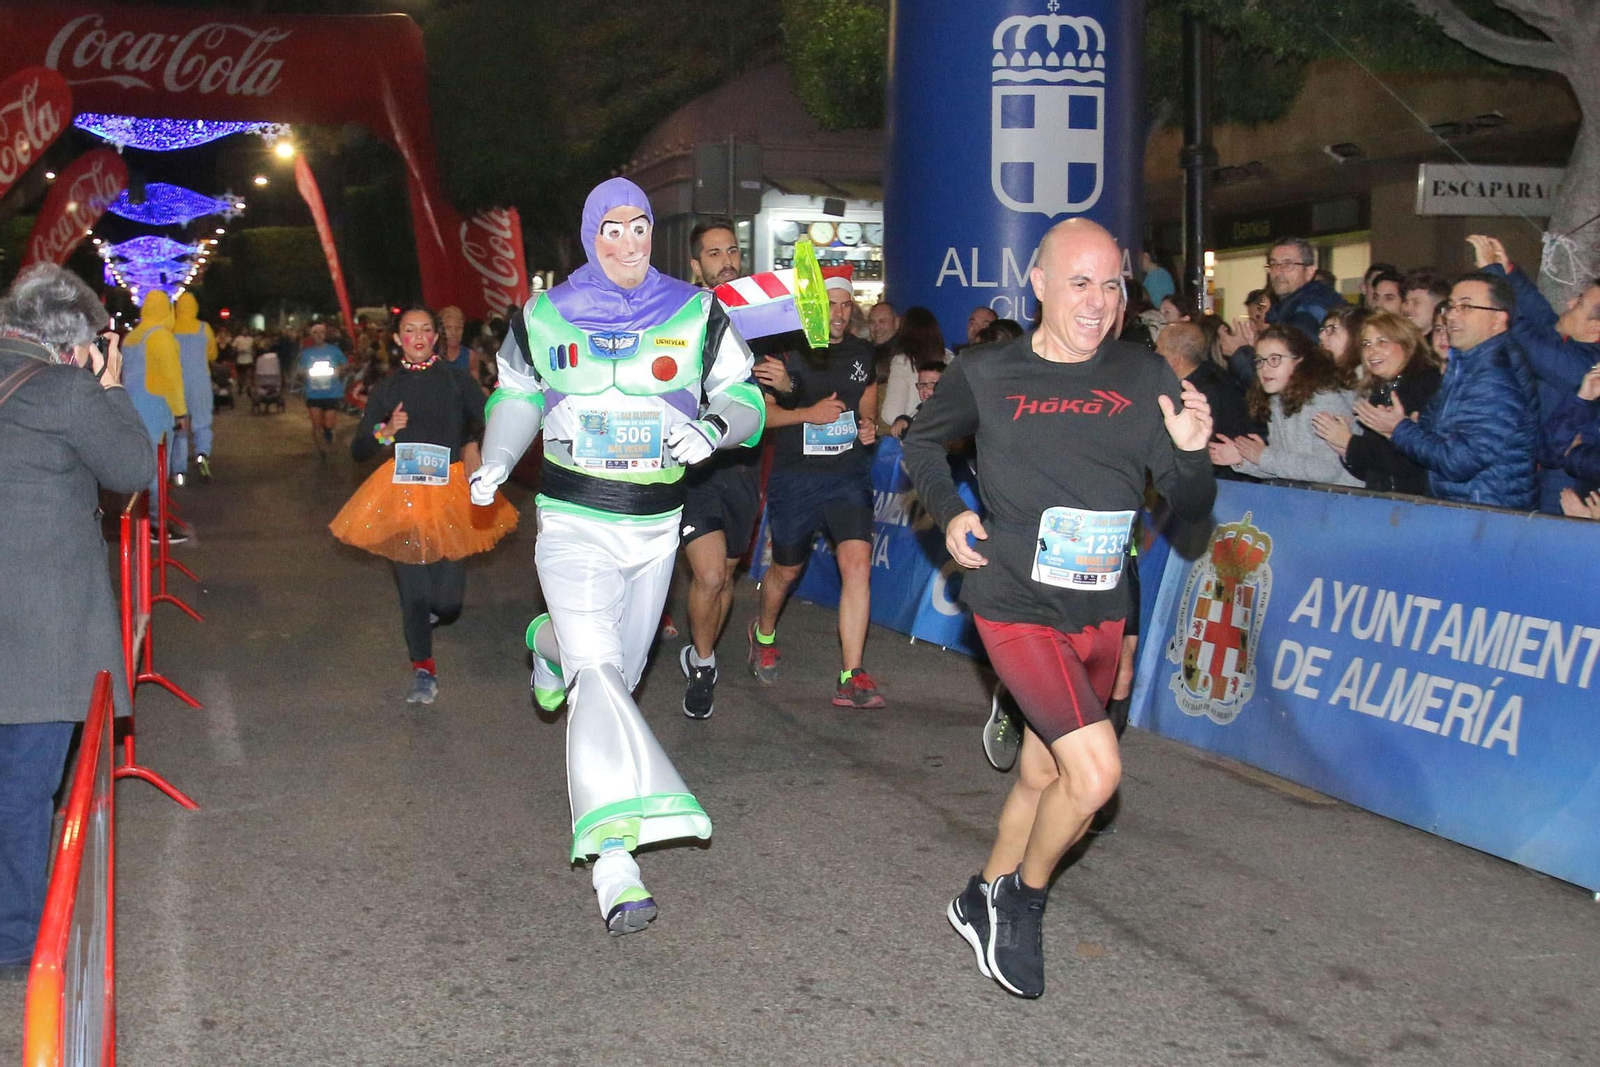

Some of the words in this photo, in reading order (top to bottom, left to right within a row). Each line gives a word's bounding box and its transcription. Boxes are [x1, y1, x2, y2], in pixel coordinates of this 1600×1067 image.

[45, 13, 292, 96] Coca-Cola
[616, 426, 652, 443] 506
[827, 423, 855, 436] 2096
[416, 455, 446, 469] 1067
[1084, 534, 1125, 555] 1233
[1272, 640, 1332, 700] DE
[1329, 676, 1522, 757] ALMERÍA
